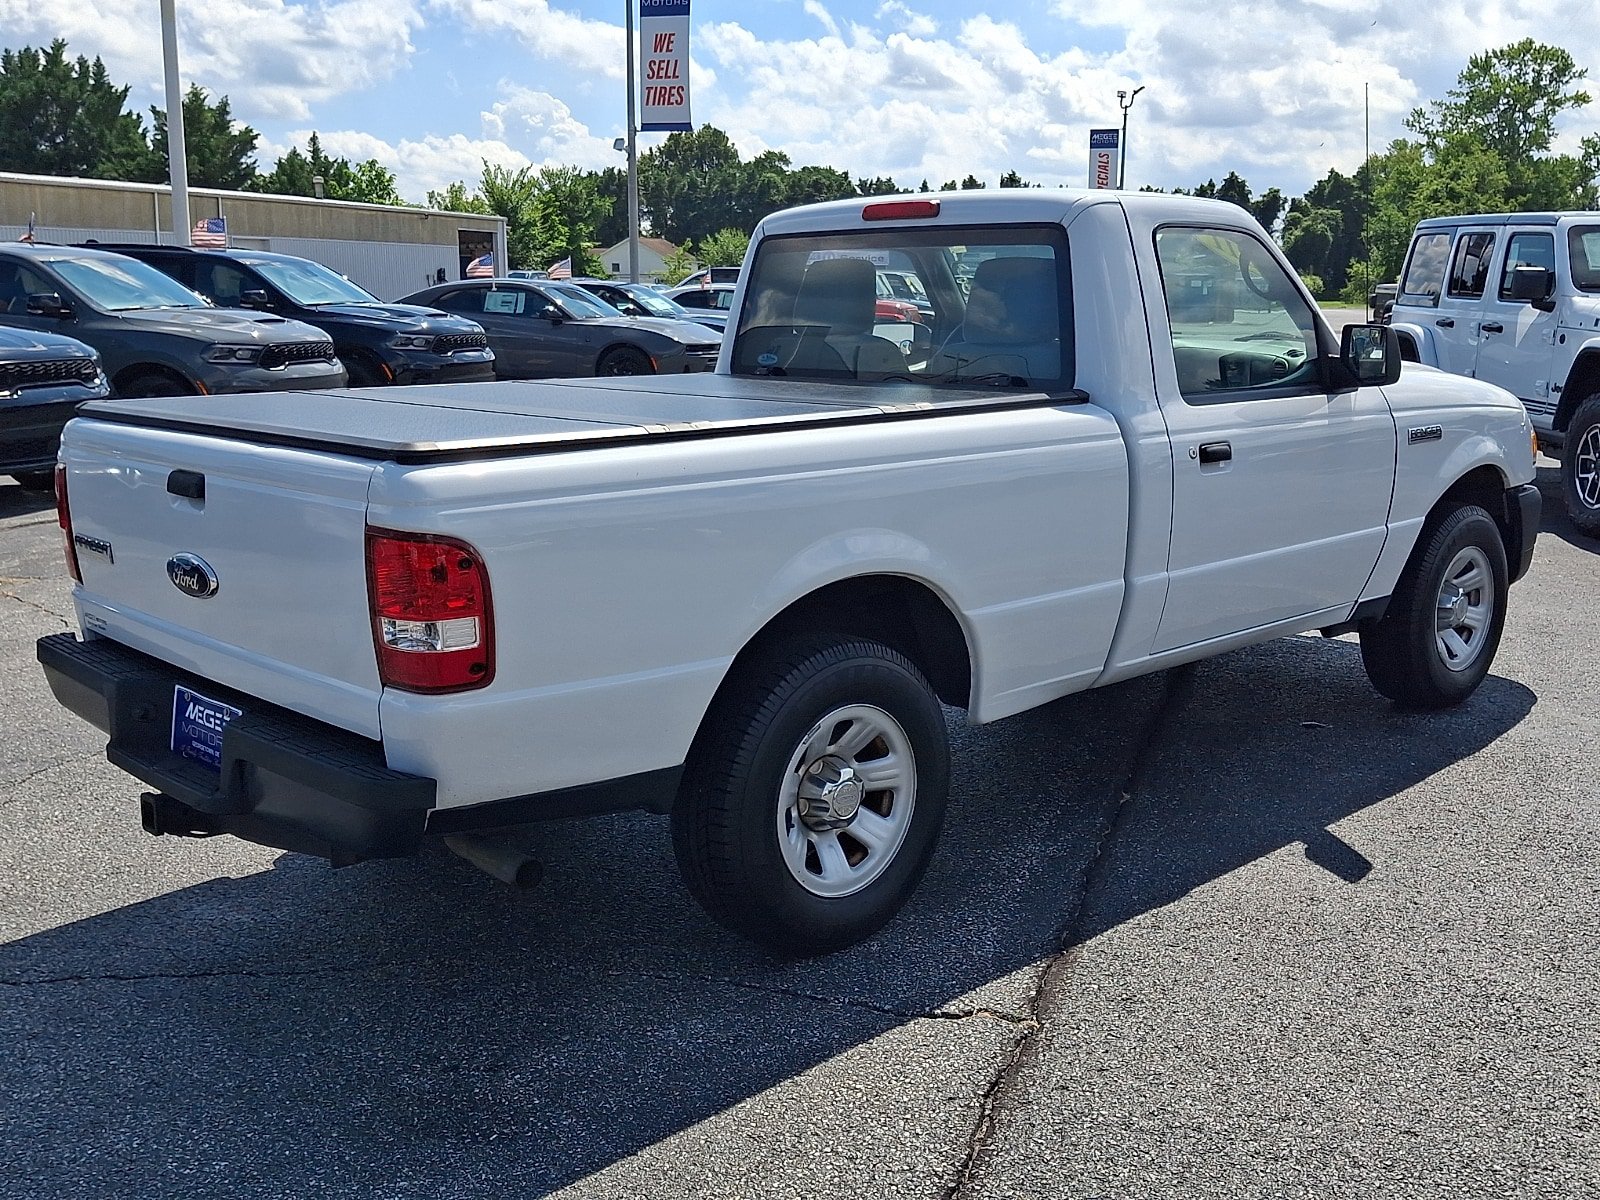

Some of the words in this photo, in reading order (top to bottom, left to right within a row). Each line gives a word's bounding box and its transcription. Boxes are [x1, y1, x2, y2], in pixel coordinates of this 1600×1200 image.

[653, 32, 676, 53] WE
[646, 59, 680, 80] SELL
[645, 85, 685, 107] TIRES
[1410, 425, 1442, 439] RANGER
[172, 565, 200, 591] Ford
